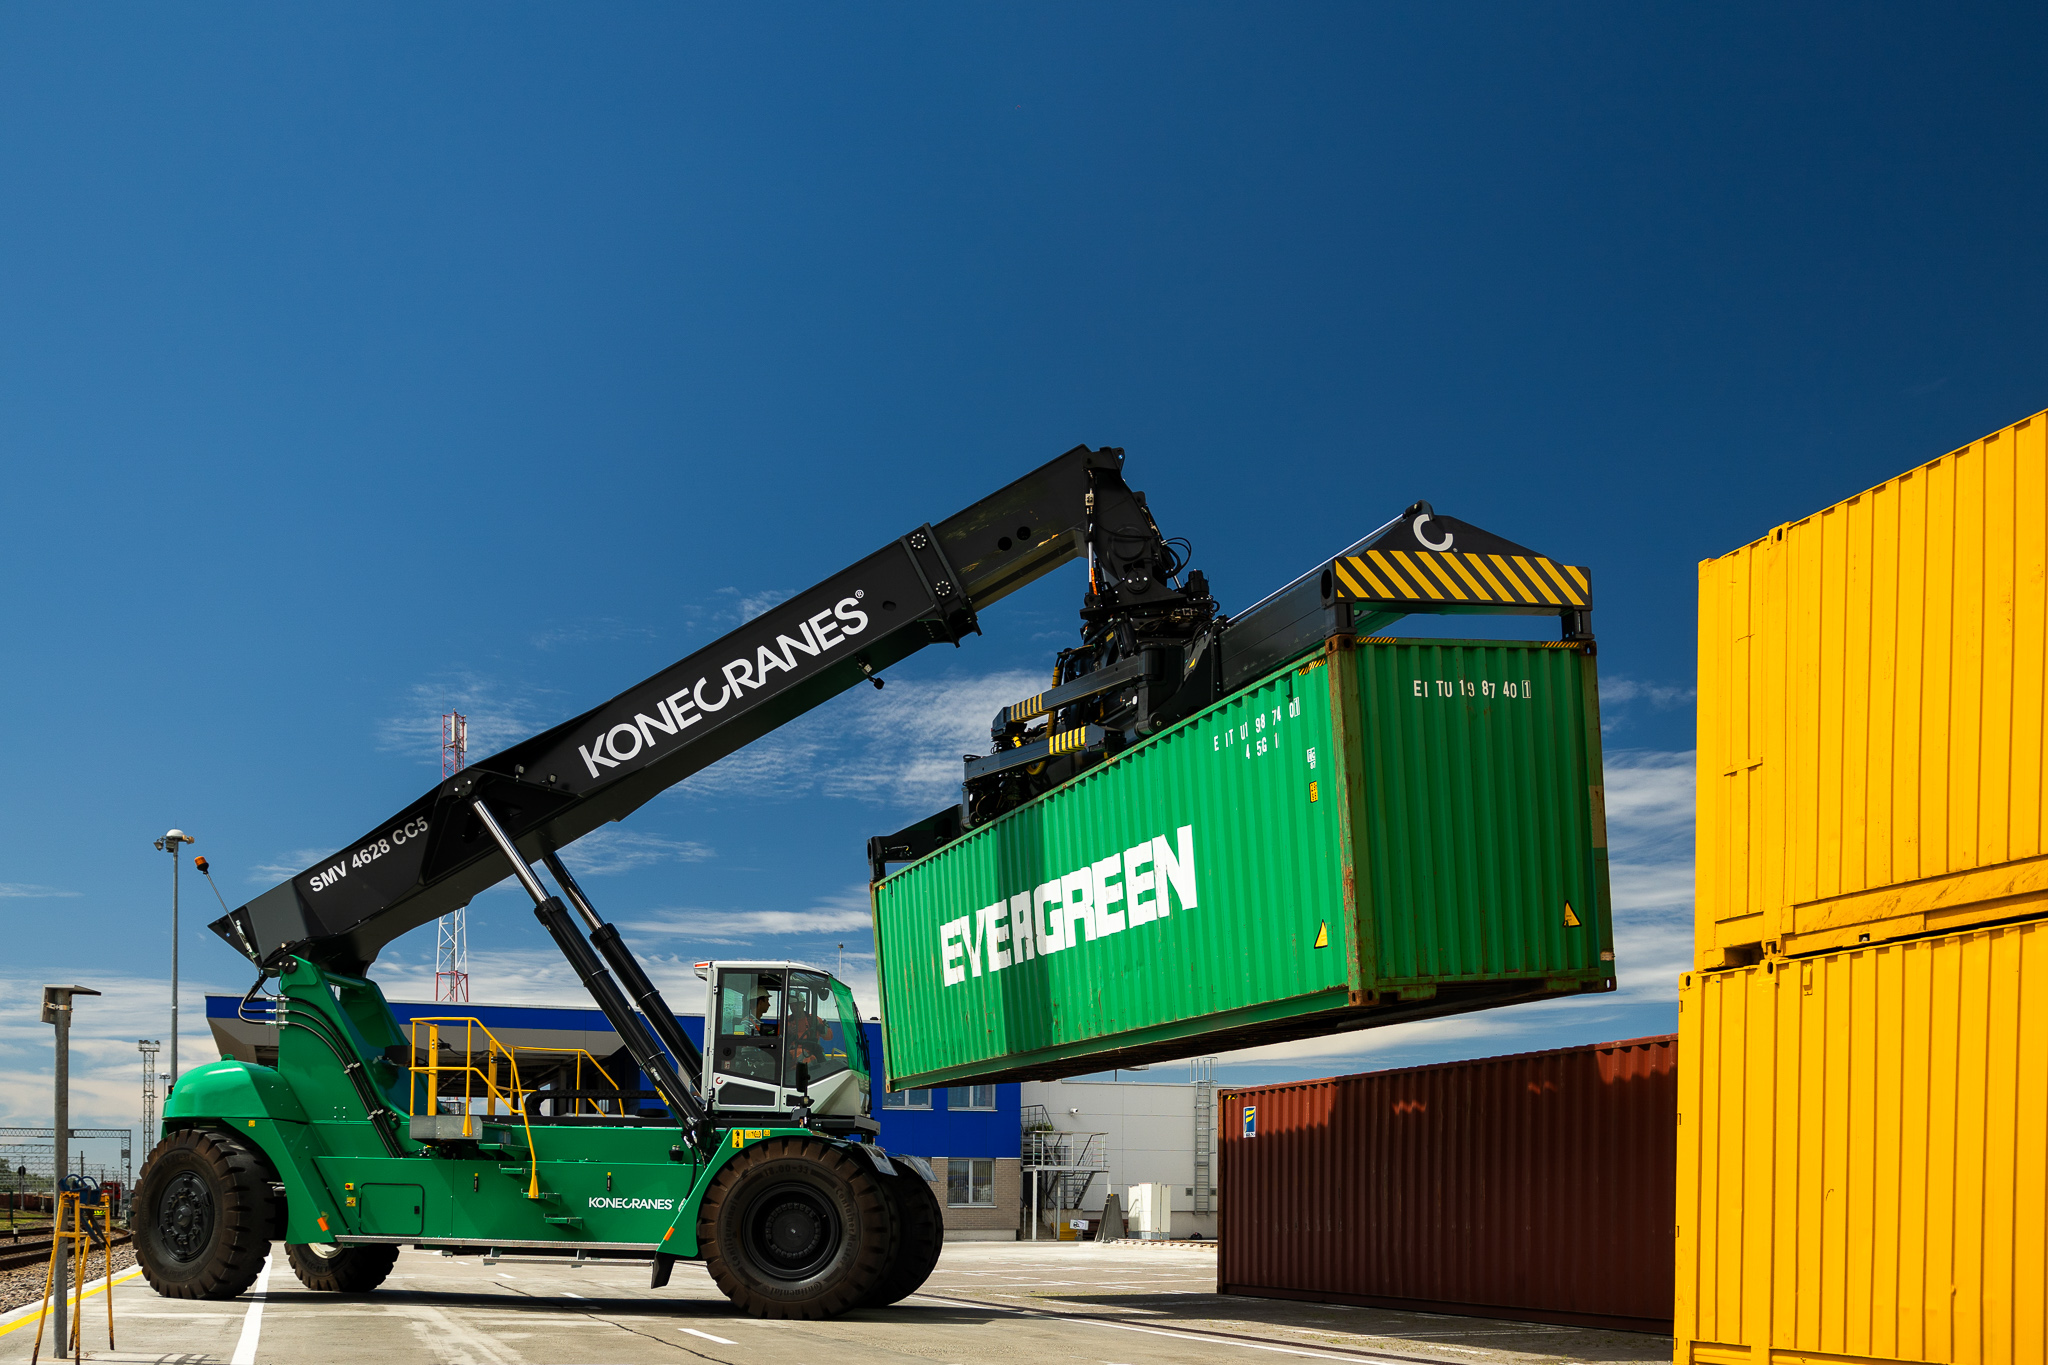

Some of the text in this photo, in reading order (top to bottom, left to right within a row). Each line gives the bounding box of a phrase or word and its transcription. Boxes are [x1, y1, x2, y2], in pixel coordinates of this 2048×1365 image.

[578, 597, 869, 779] KONECRANES
[309, 816, 428, 892] SMV 4628 CC5
[940, 824, 1198, 988] EVERGREEN
[588, 1196, 673, 1211] KONECRANES
